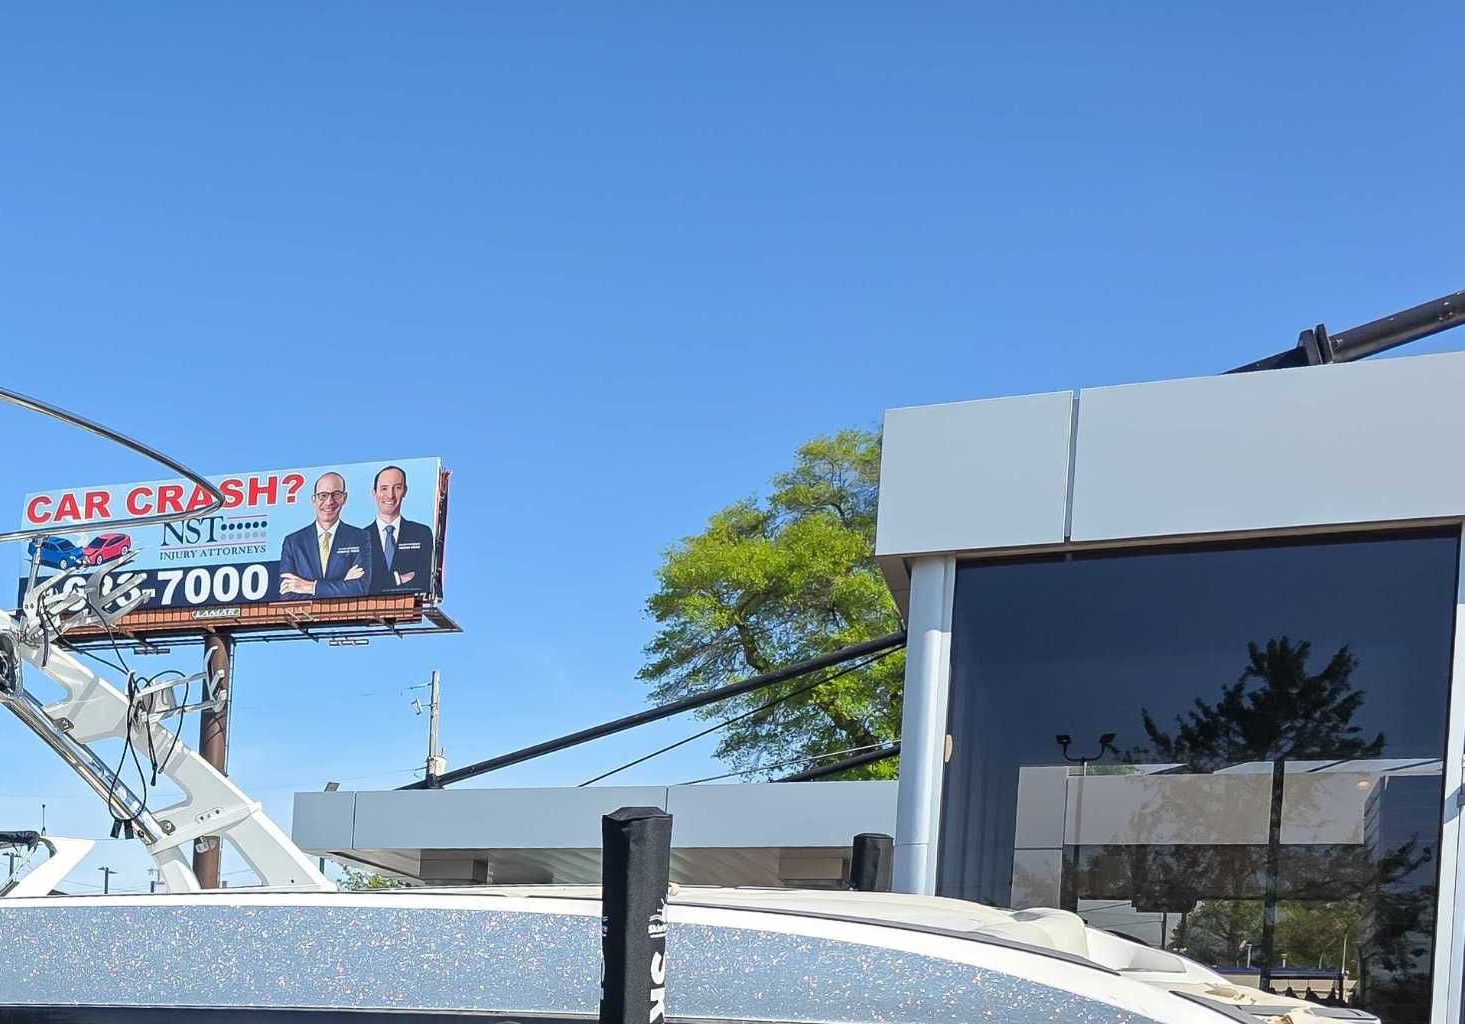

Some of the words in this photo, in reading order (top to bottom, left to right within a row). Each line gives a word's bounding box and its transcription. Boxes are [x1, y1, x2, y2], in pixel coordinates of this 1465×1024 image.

[26, 489, 112, 525] CAR
[126, 473, 306, 517] CRASH?
[162, 515, 224, 547] NST
[159, 549, 196, 561] INJURY
[199, 544, 267, 558] ATTORNEYS
